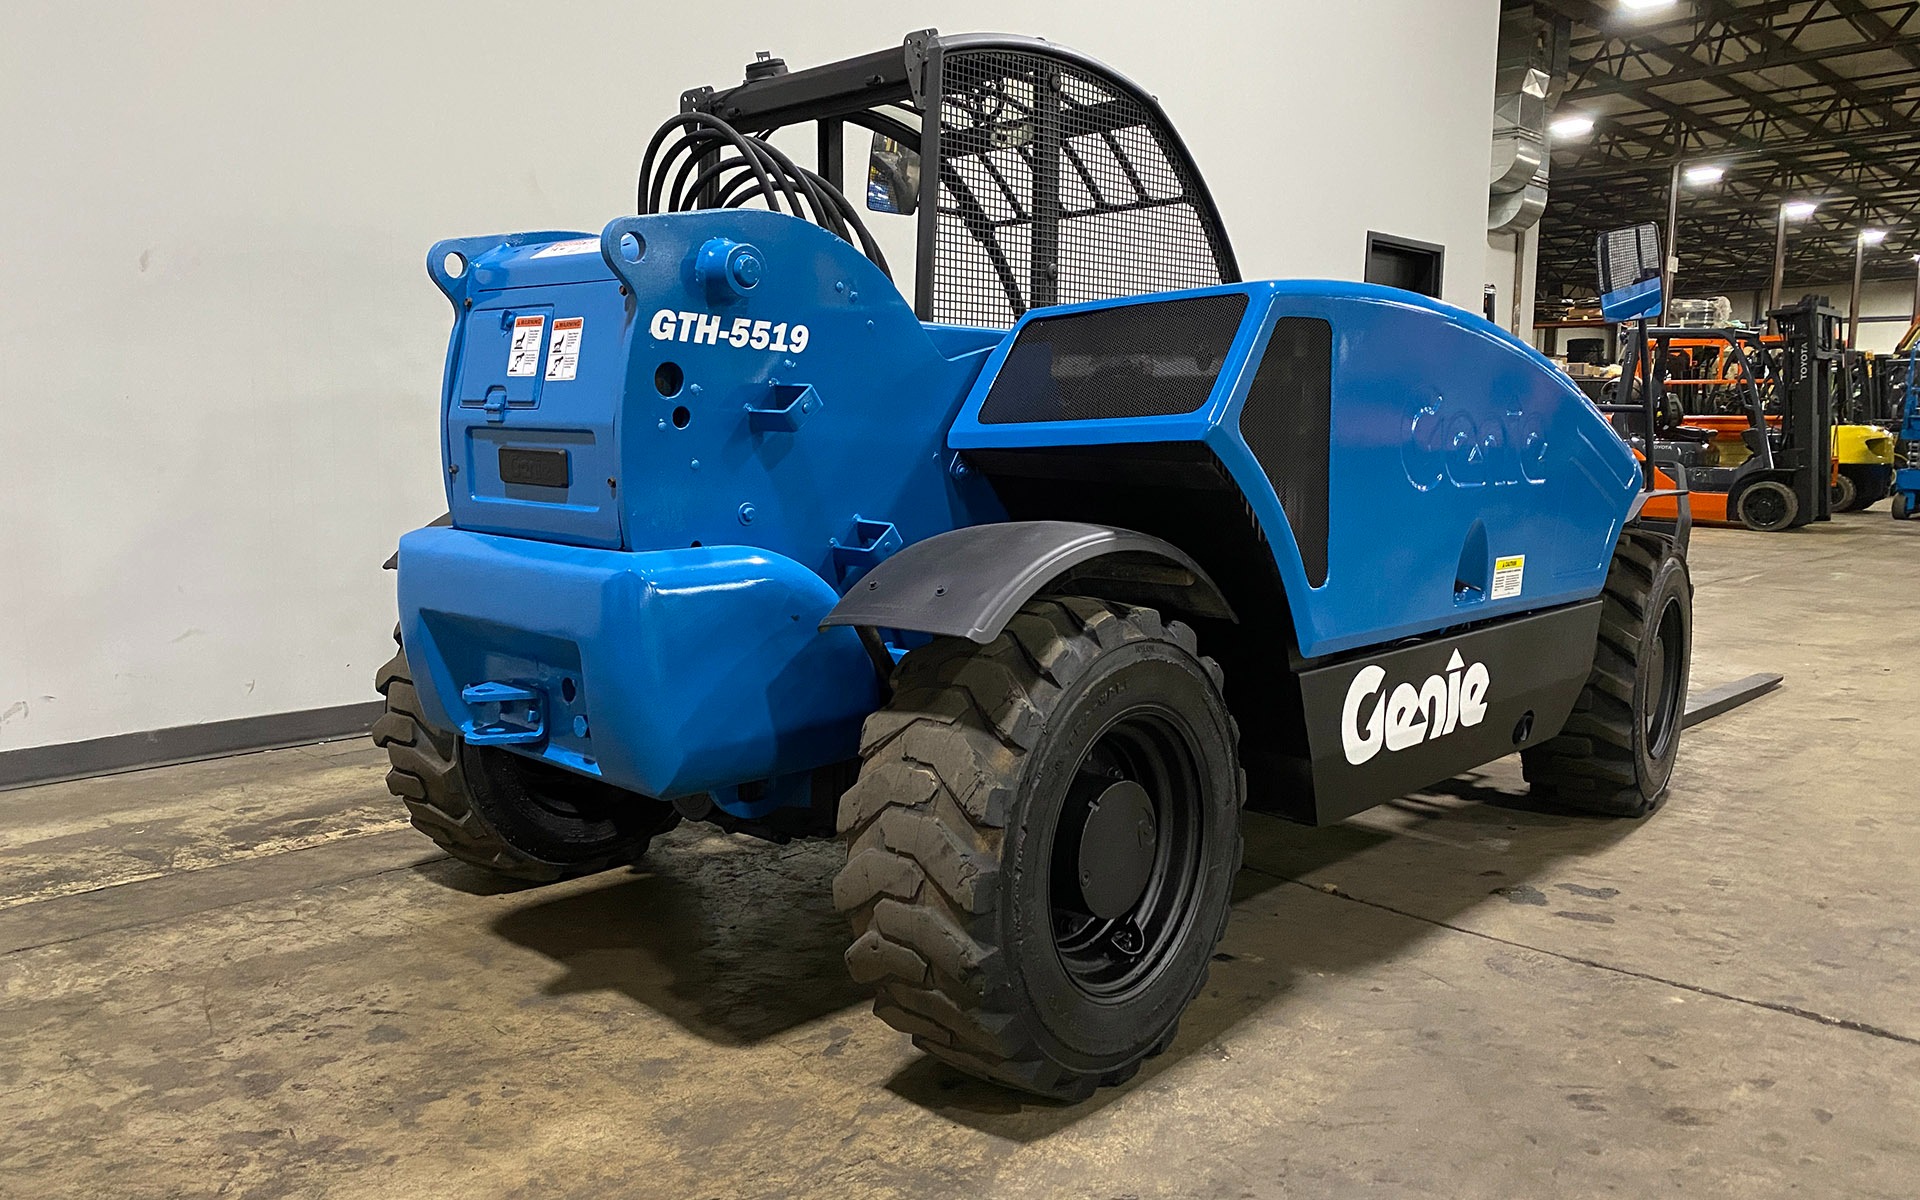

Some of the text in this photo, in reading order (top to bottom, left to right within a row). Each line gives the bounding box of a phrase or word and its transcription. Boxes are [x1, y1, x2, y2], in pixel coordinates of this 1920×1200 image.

[650, 309, 809, 354] GTH-5519
[1800, 342, 1809, 381] TOYOTA
[1341, 647, 1491, 766] Genie
